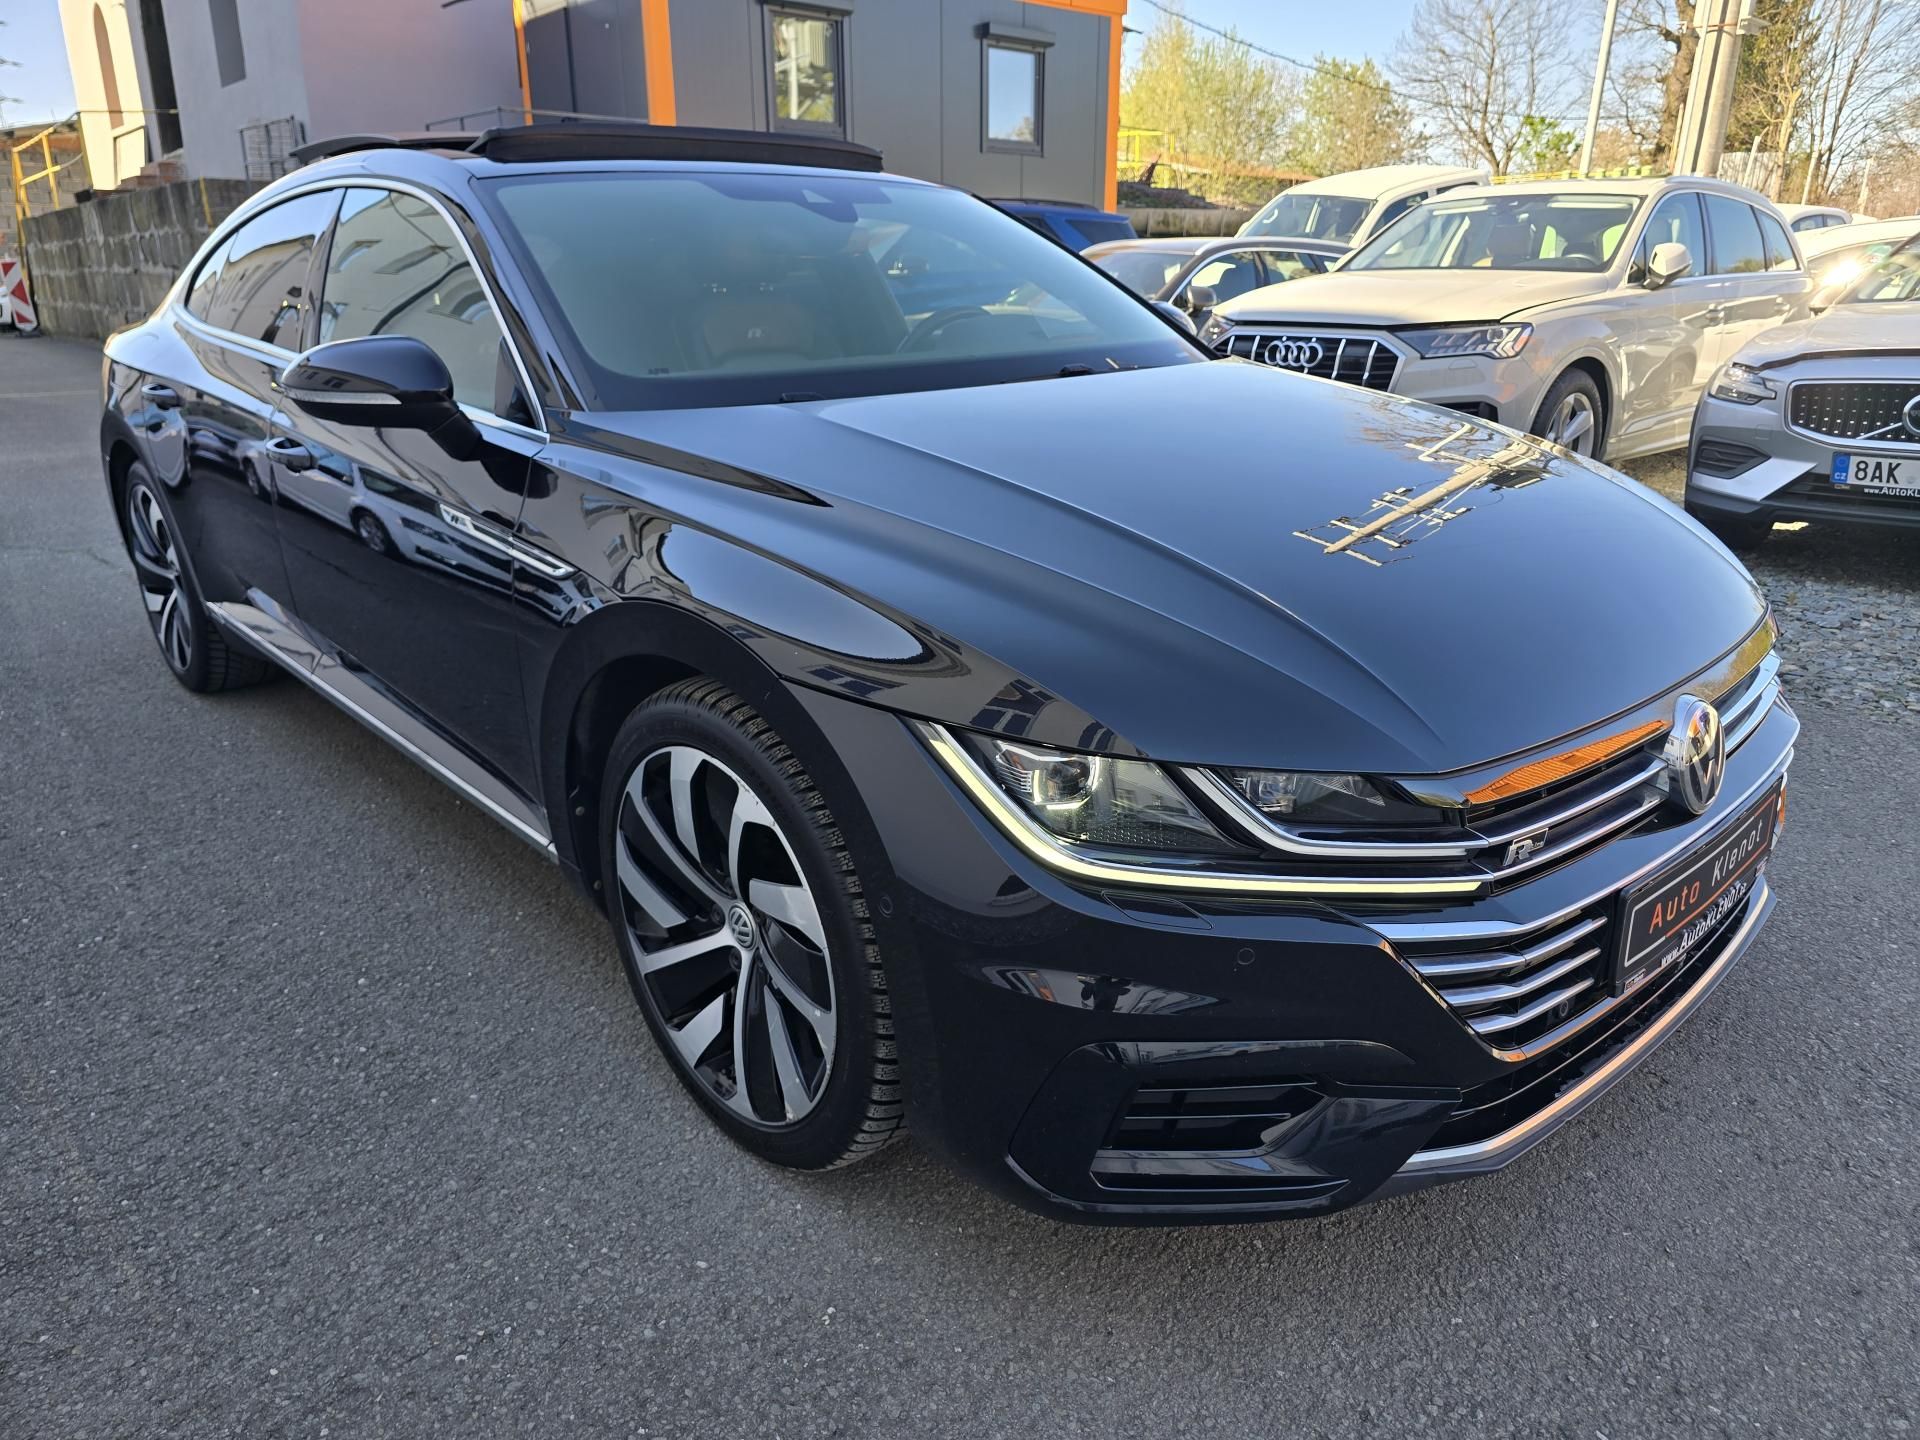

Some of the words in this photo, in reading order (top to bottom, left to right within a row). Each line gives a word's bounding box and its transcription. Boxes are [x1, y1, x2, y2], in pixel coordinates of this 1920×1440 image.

[1834, 472, 1847, 480] CZ
[1854, 460, 1902, 485] 8AK
[1649, 880, 1700, 934] Auto
[1711, 819, 1763, 887] Klenot
